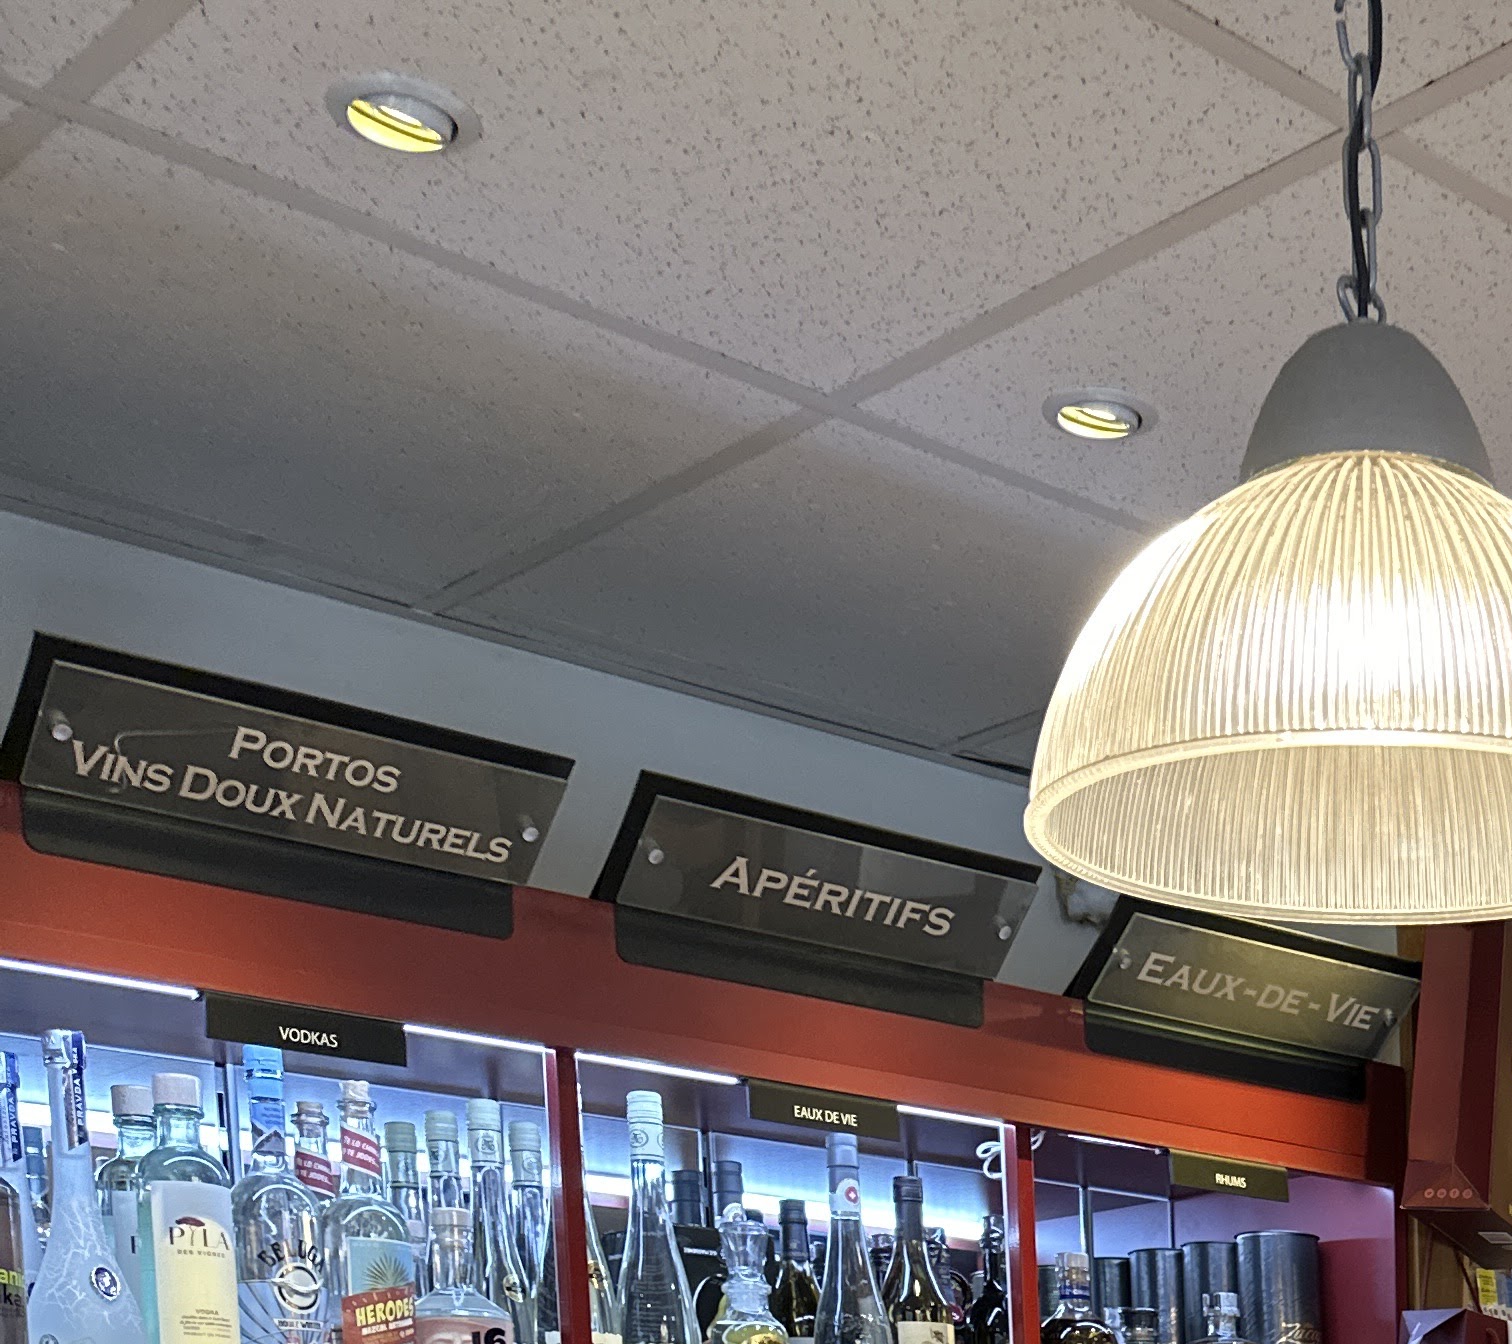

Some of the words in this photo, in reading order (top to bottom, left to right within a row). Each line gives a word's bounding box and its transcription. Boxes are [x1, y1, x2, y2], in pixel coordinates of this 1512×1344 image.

[229, 725, 400, 793] PORTOS
[69, 740, 172, 792] VINS
[180, 766, 303, 822] DOUX
[305, 794, 512, 864] NATURELS
[710, 855, 956, 937] APÉRITIFS
[279, 1026, 338, 1049] VODKAS
[793, 1104, 822, 1122] EAUX
[825, 1109, 839, 1124] DE
[840, 1111, 858, 1127] VIE
[1215, 1172, 1247, 1189] RHUMS
[168, 1225, 231, 1251] PYLA
[355, 1298, 415, 1327] HERODES
